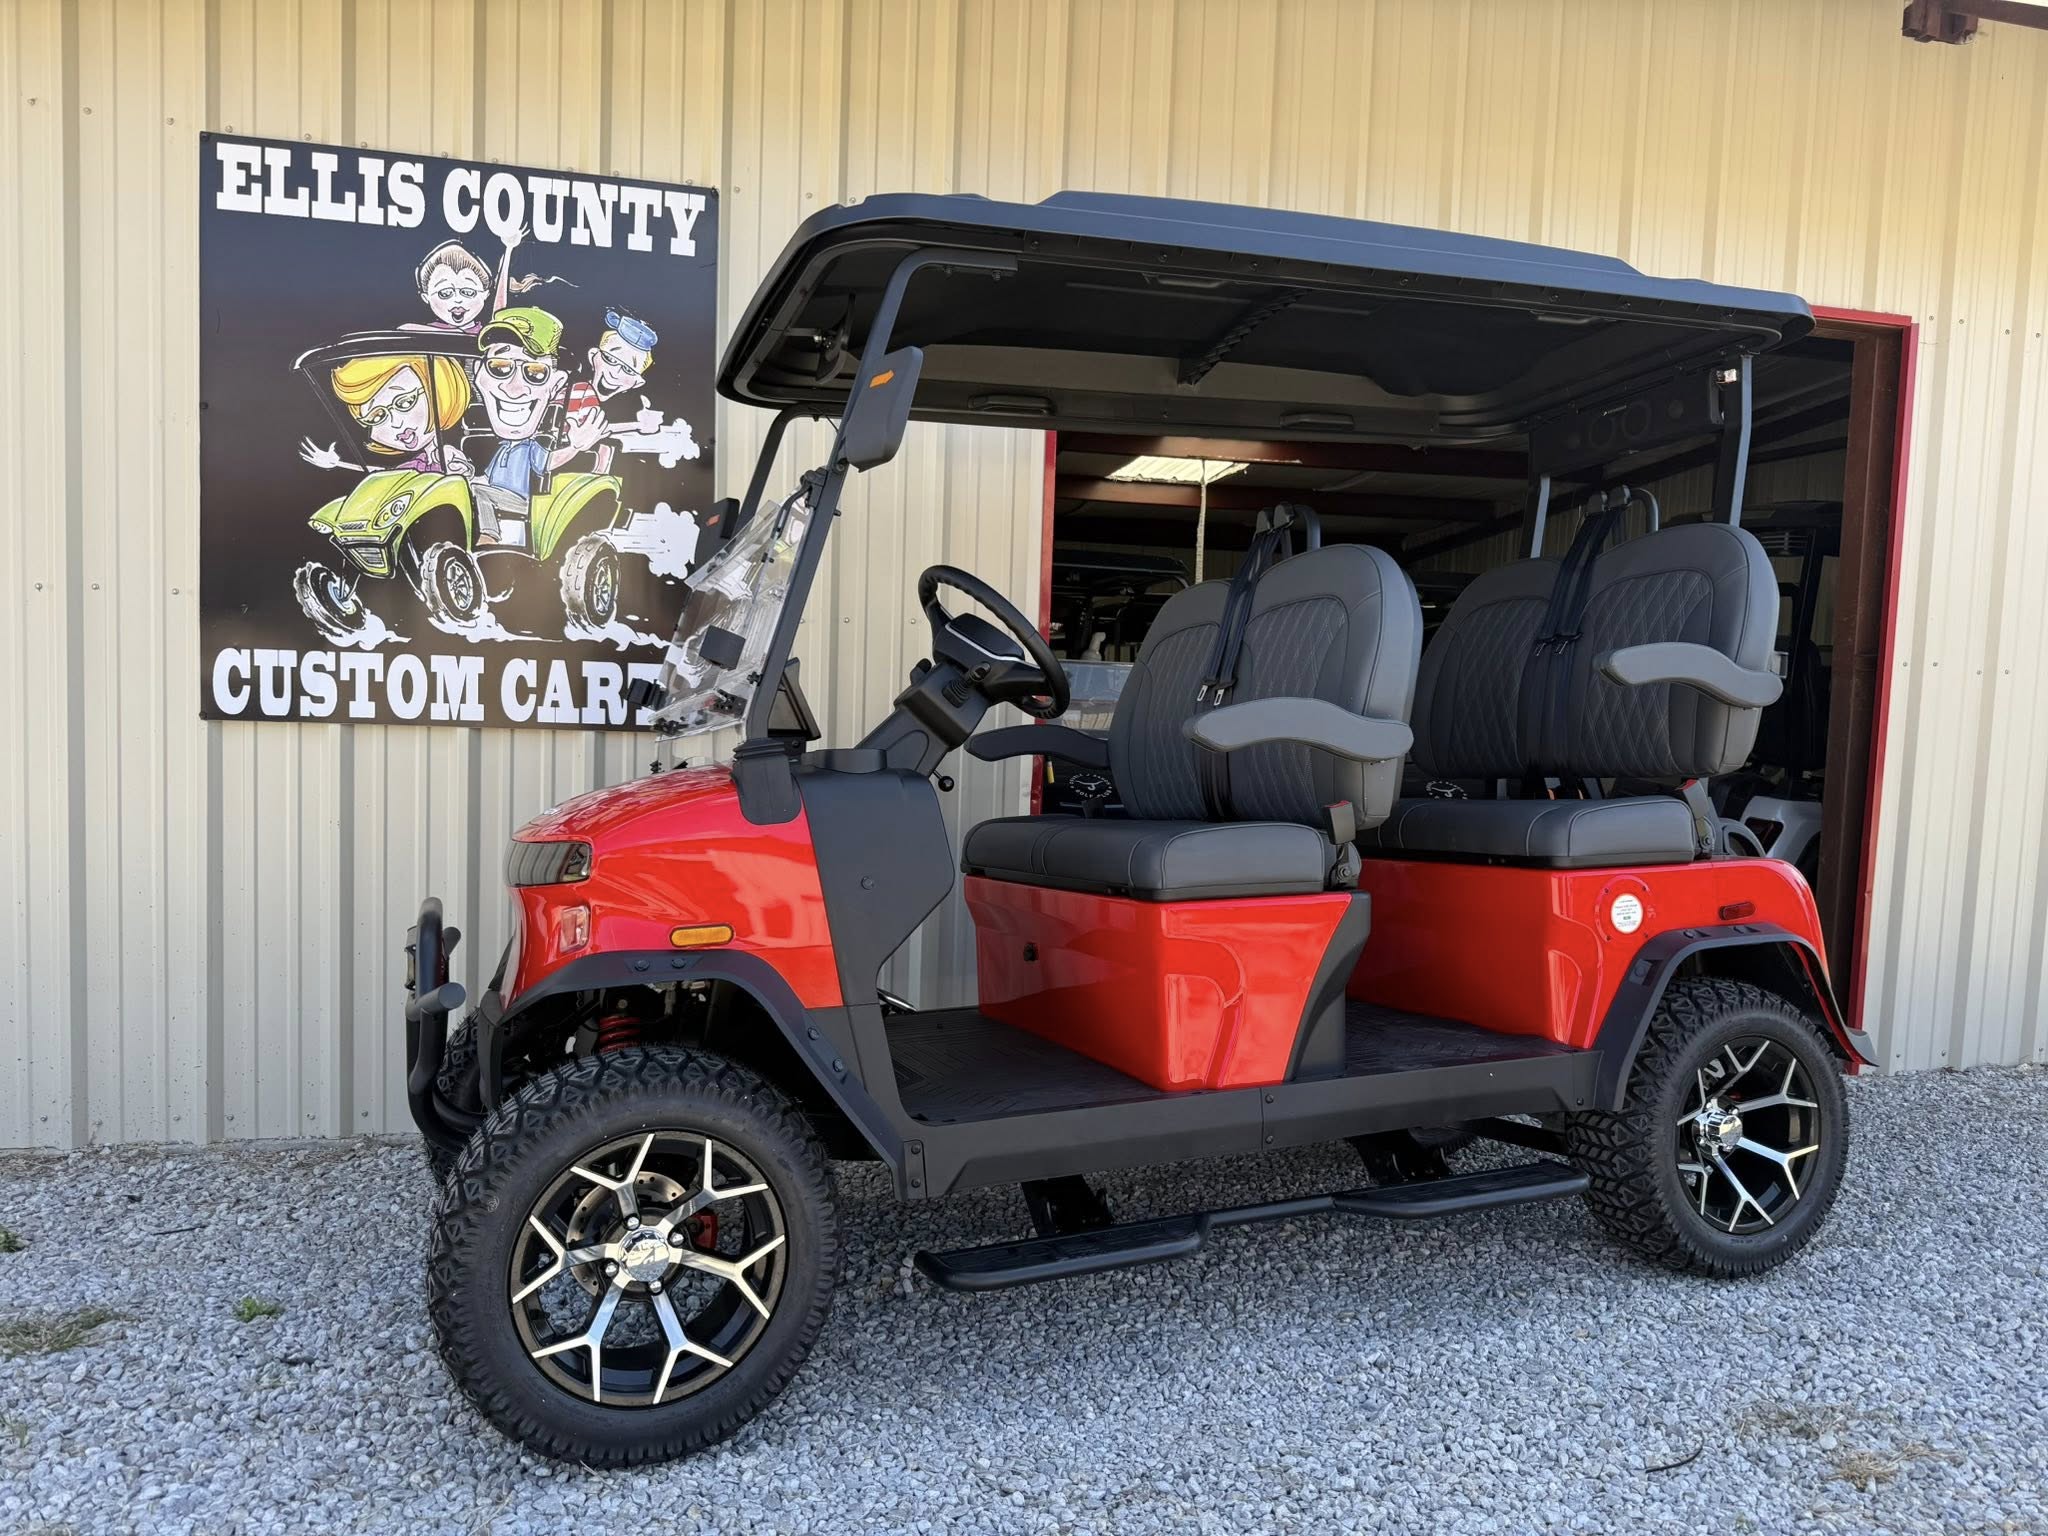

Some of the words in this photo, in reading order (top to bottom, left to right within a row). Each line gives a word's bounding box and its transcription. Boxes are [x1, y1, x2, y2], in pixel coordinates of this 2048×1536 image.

[216, 142, 426, 228] ELLIS
[442, 168, 706, 257] COUNTY
[212, 648, 485, 722] CUSTOM
[500, 657, 692, 726] CART
